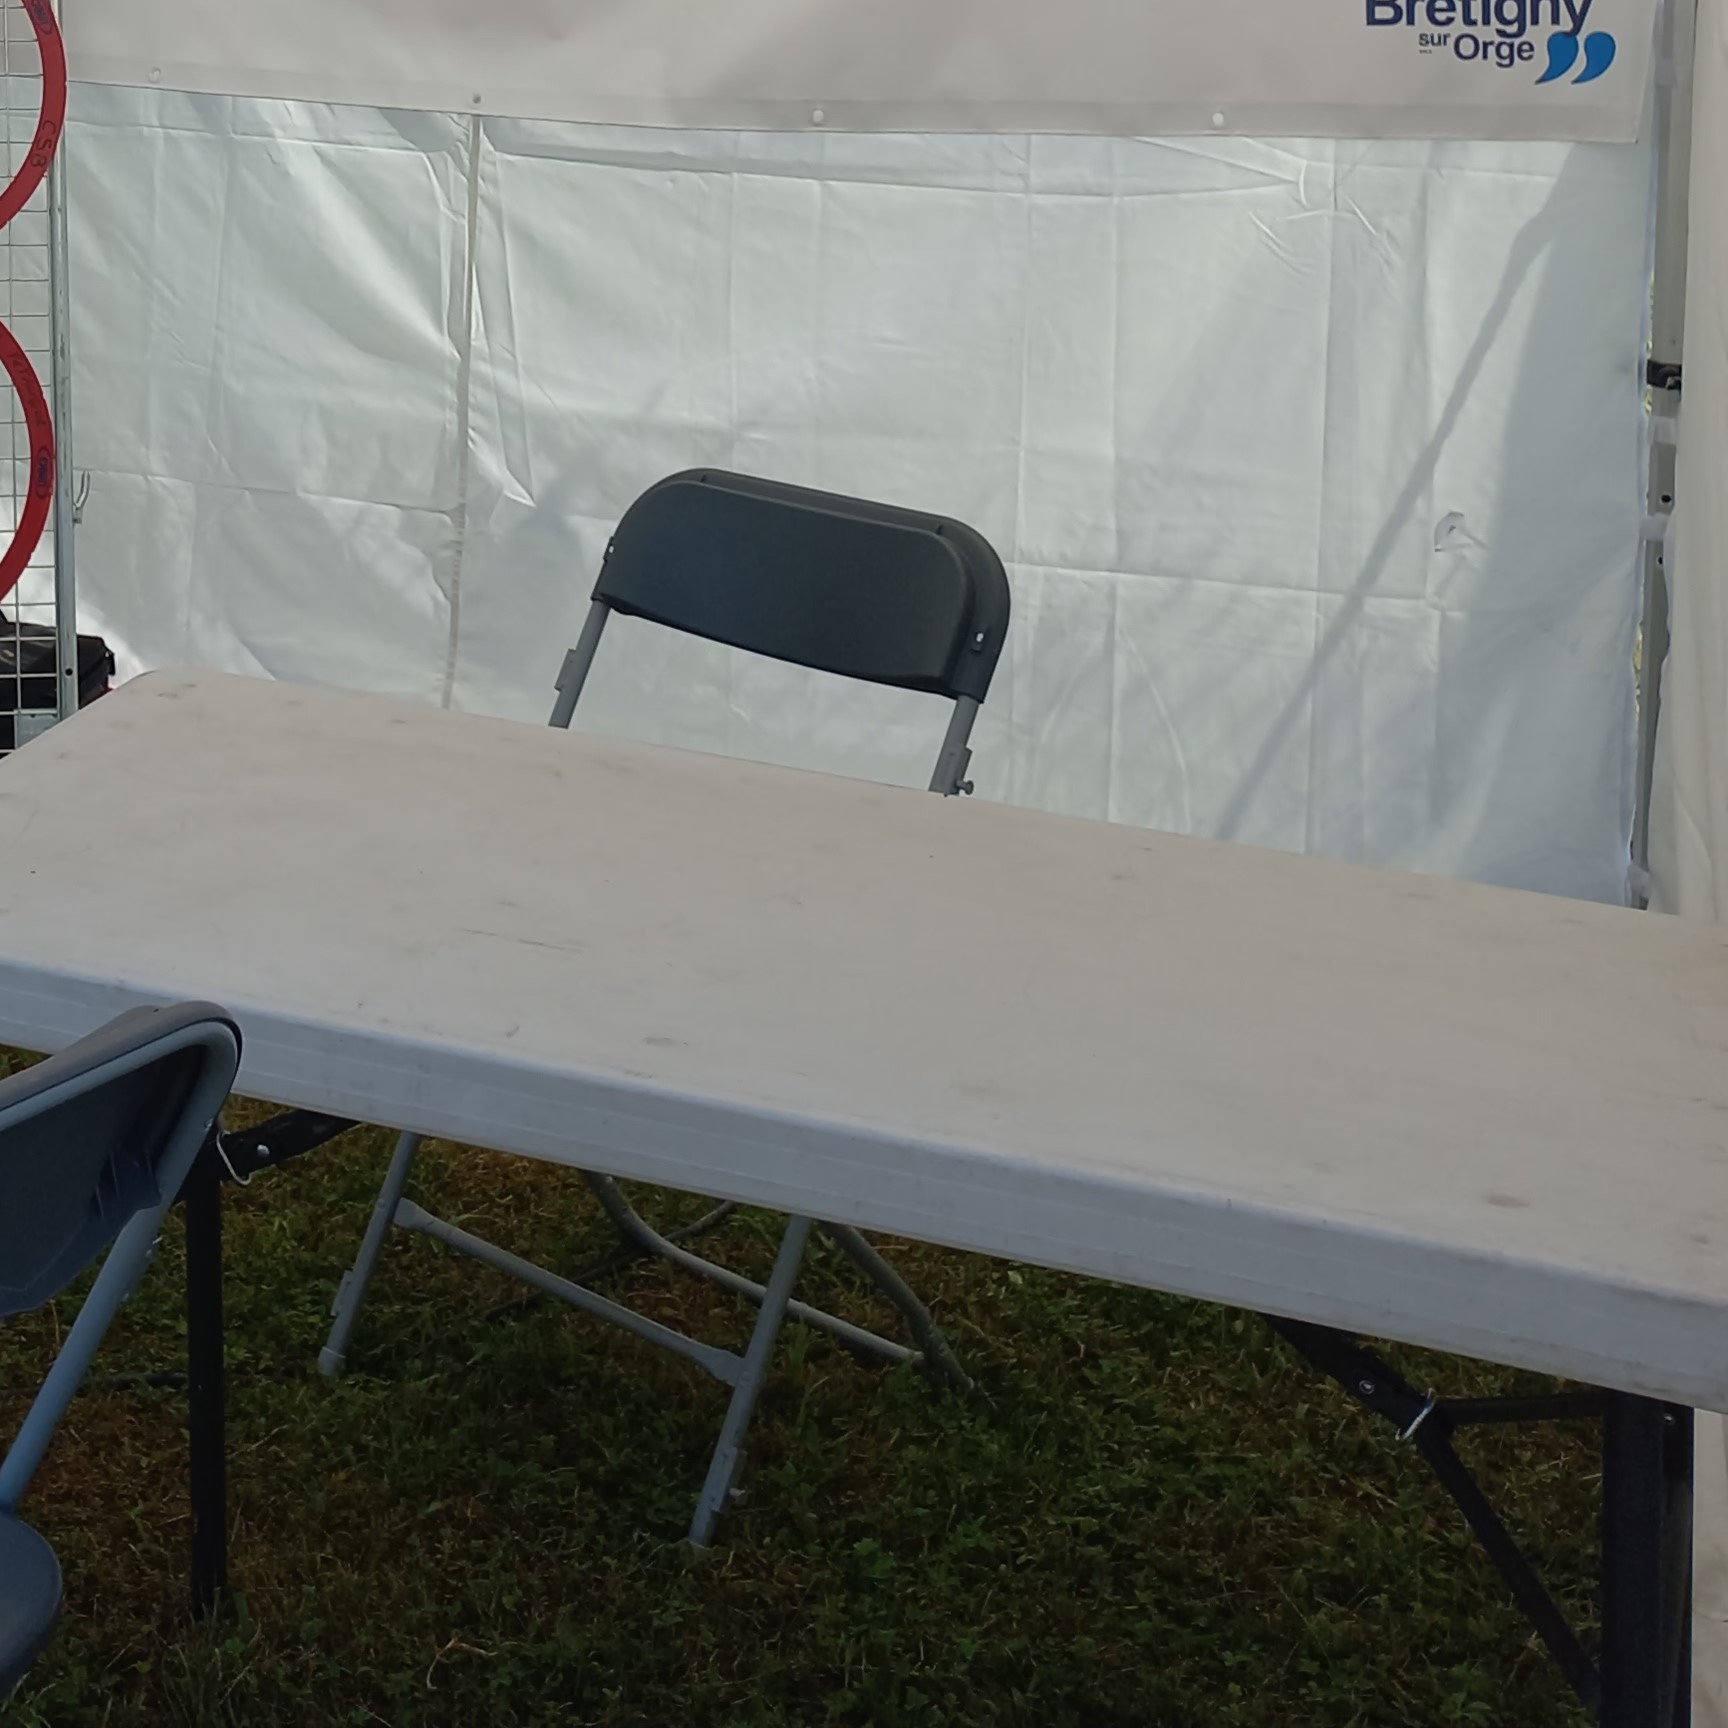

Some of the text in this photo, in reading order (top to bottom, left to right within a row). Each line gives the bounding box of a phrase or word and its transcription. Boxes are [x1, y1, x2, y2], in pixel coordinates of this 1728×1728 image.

[1418, 32, 1535, 68] sur Orge
[29, 119, 57, 169] CSB
